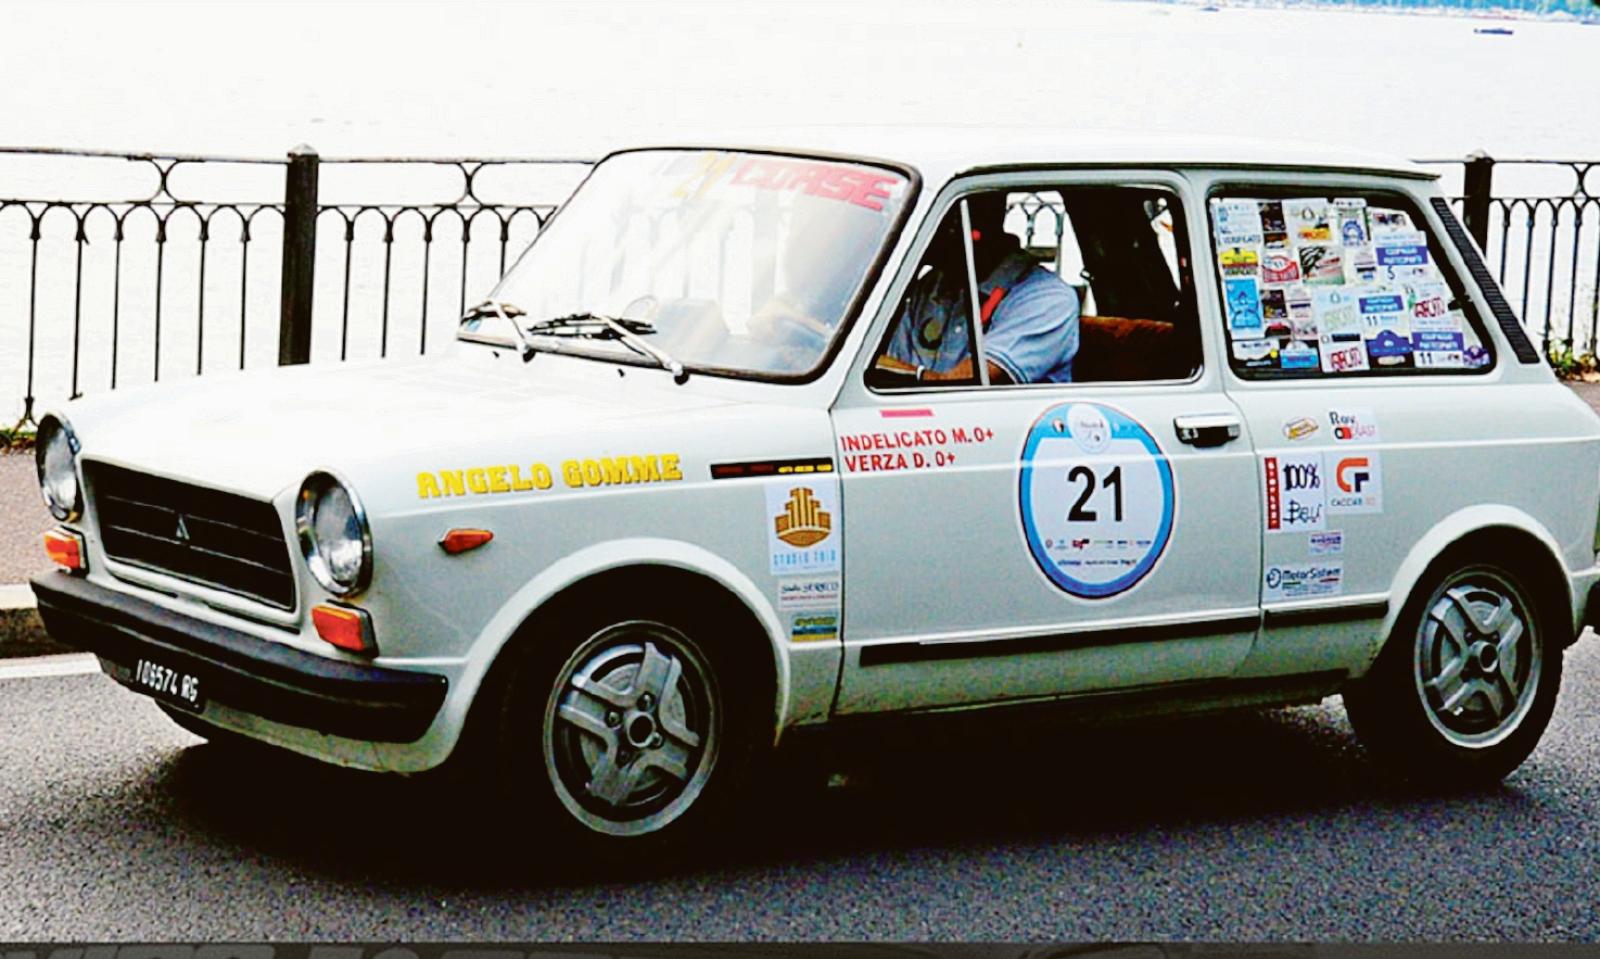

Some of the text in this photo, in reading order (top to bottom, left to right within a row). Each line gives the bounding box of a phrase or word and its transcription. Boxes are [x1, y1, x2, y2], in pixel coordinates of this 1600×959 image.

[1419, 352, 1433, 364] 11
[840, 428, 947, 452] INDELICATO
[951, 427, 973, 444] M.
[844, 453, 909, 473] VERZA
[913, 452, 931, 469] D.
[416, 453, 684, 500] ANGELO GOMME
[1283, 463, 1321, 492] 100%
[1066, 465, 1124, 523] 21
